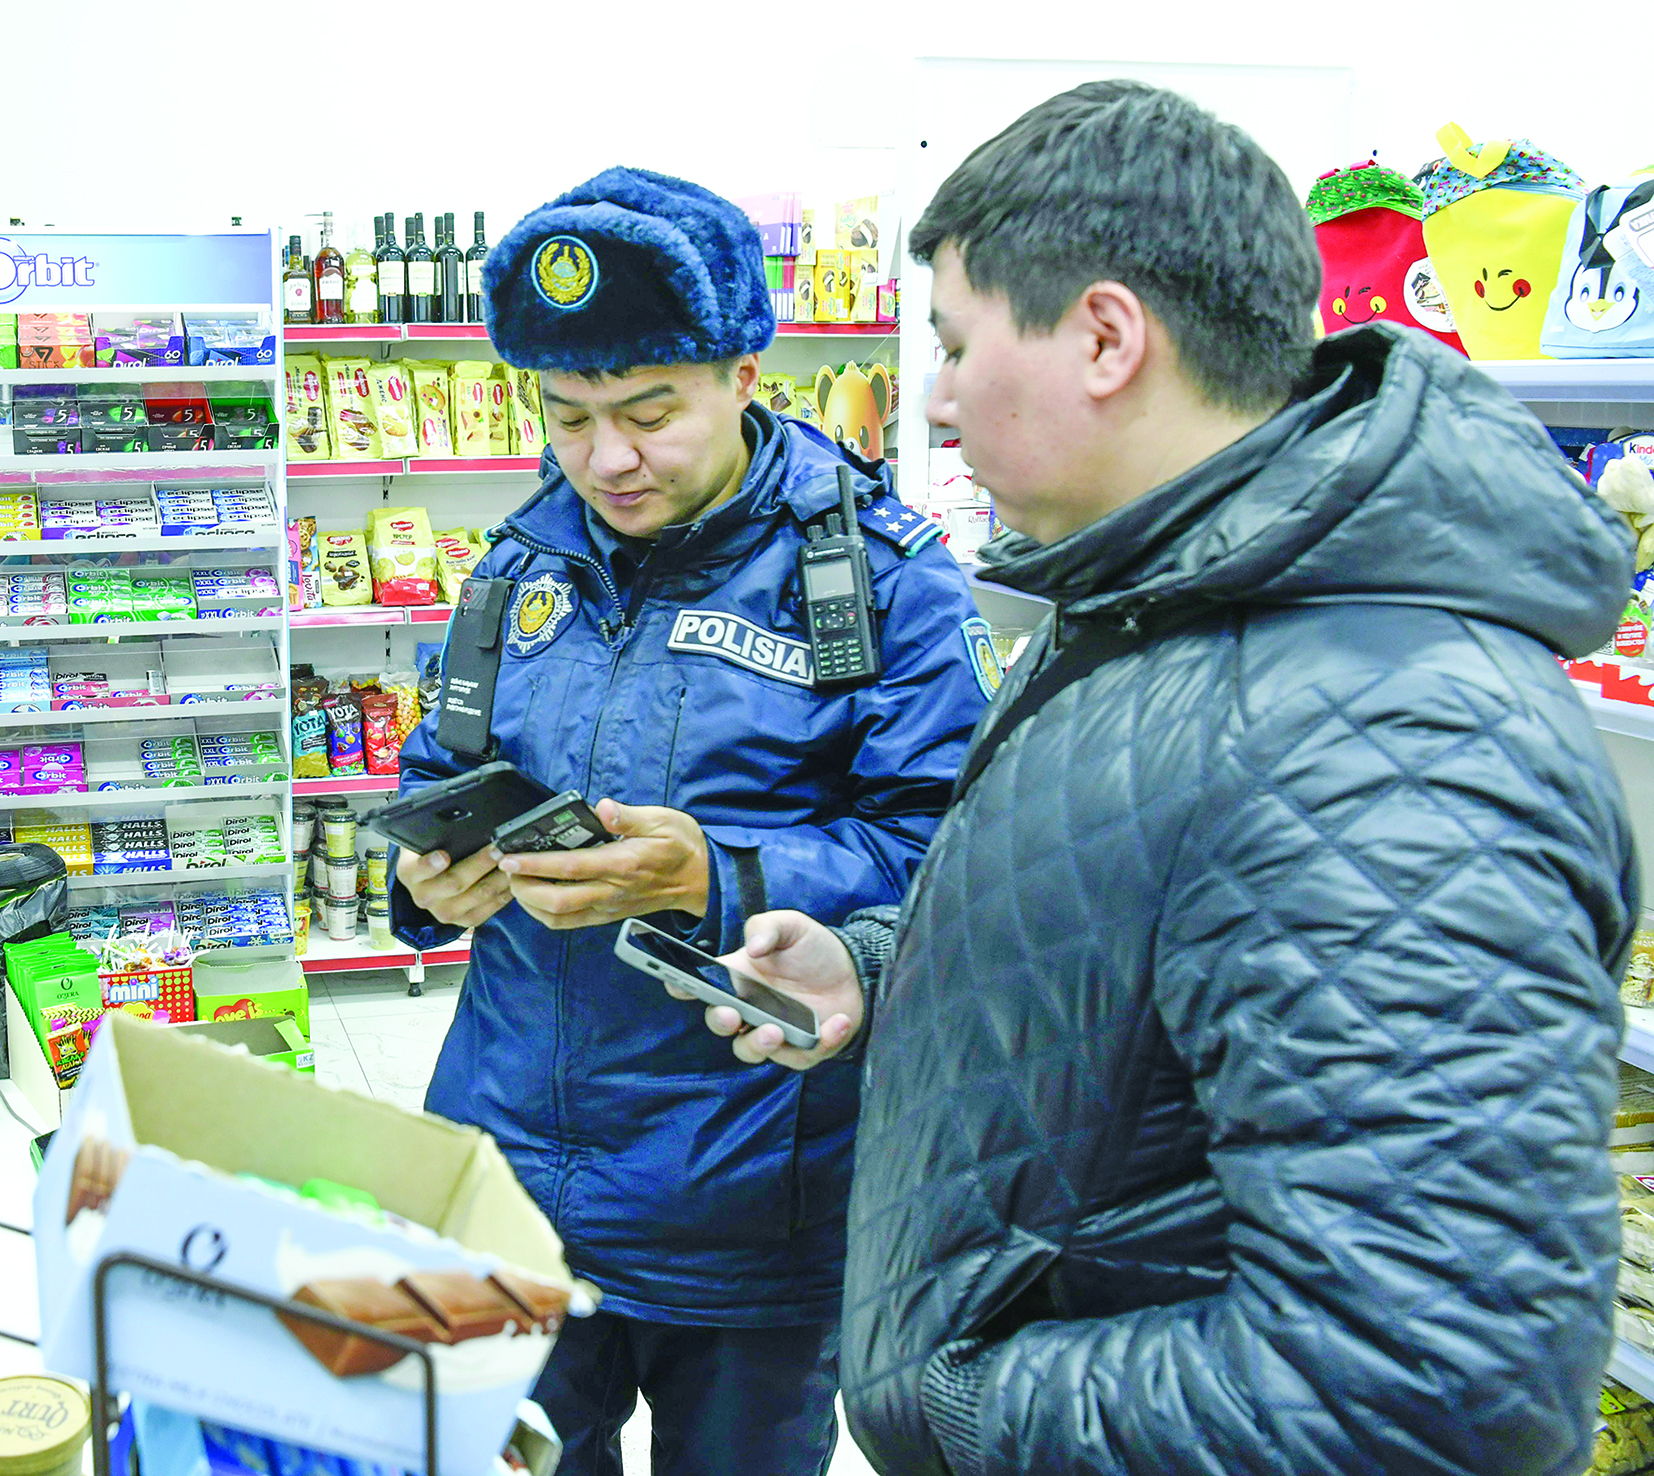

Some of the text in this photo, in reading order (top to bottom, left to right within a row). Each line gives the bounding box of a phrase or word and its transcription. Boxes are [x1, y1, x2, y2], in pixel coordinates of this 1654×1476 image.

[164, 350, 181, 360] 60
[256, 350, 273, 359] 60
[123, 406, 133, 421] 5
[184, 409, 193, 421] 5
[227, 505, 269, 513] eclipse
[229, 513, 272, 521] eclipse
[73, 583, 106, 592] Orbit
[204, 608, 256, 619] XXL Orbit
[675, 615, 809, 678] POLISIA
[56, 683, 87, 693] Orbit
[327, 704, 358, 721] YOTA
[294, 716, 326, 736] YOTA
[141, 751, 172, 760] Orbit
[145, 761, 175, 771] Orbit
[32, 770, 67, 781] Orbit
[210, 775, 262, 785] XXL Orbit
[123, 821, 162, 829] HALLS
[225, 818, 248, 826] Dirol
[124, 830, 164, 838] HALLS
[173, 831, 195, 839] Dirol
[228, 828, 250, 836] Dirol
[125, 839, 165, 849] HALLS
[174, 841, 196, 850] Dirol
[230, 838, 252, 846] Dirol
[126, 850, 167, 860] HALLS
[205, 905, 229, 914] Dirol
[125, 918, 149, 927] Dirol
[207, 916, 231, 925] Dirol
[209, 927, 233, 936] Dirol
[110, 976, 160, 1003] mini
